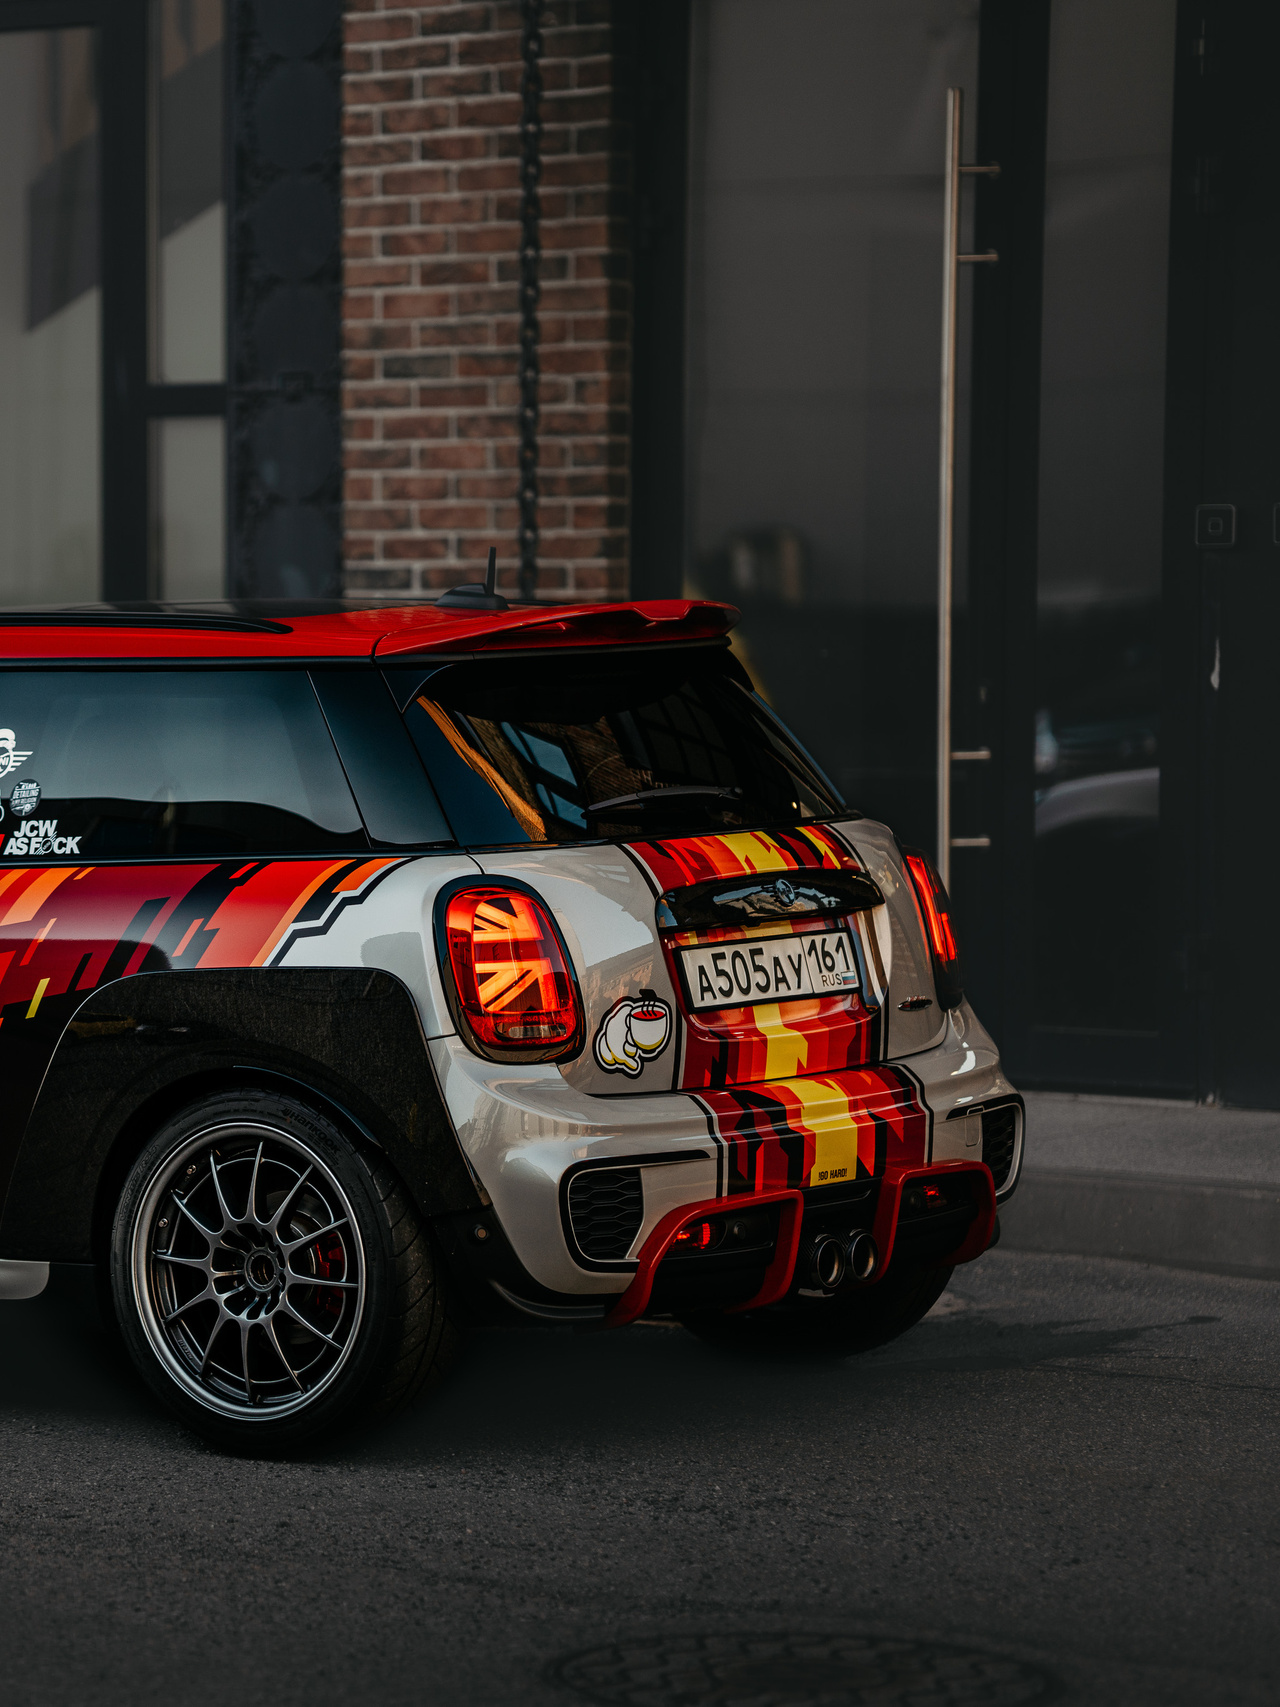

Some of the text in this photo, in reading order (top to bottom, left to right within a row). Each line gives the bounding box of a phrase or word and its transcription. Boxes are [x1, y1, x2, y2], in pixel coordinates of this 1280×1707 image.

[14, 820, 58, 838] JCW
[807, 935, 851, 974] 161
[822, 973, 842, 987] RUS
